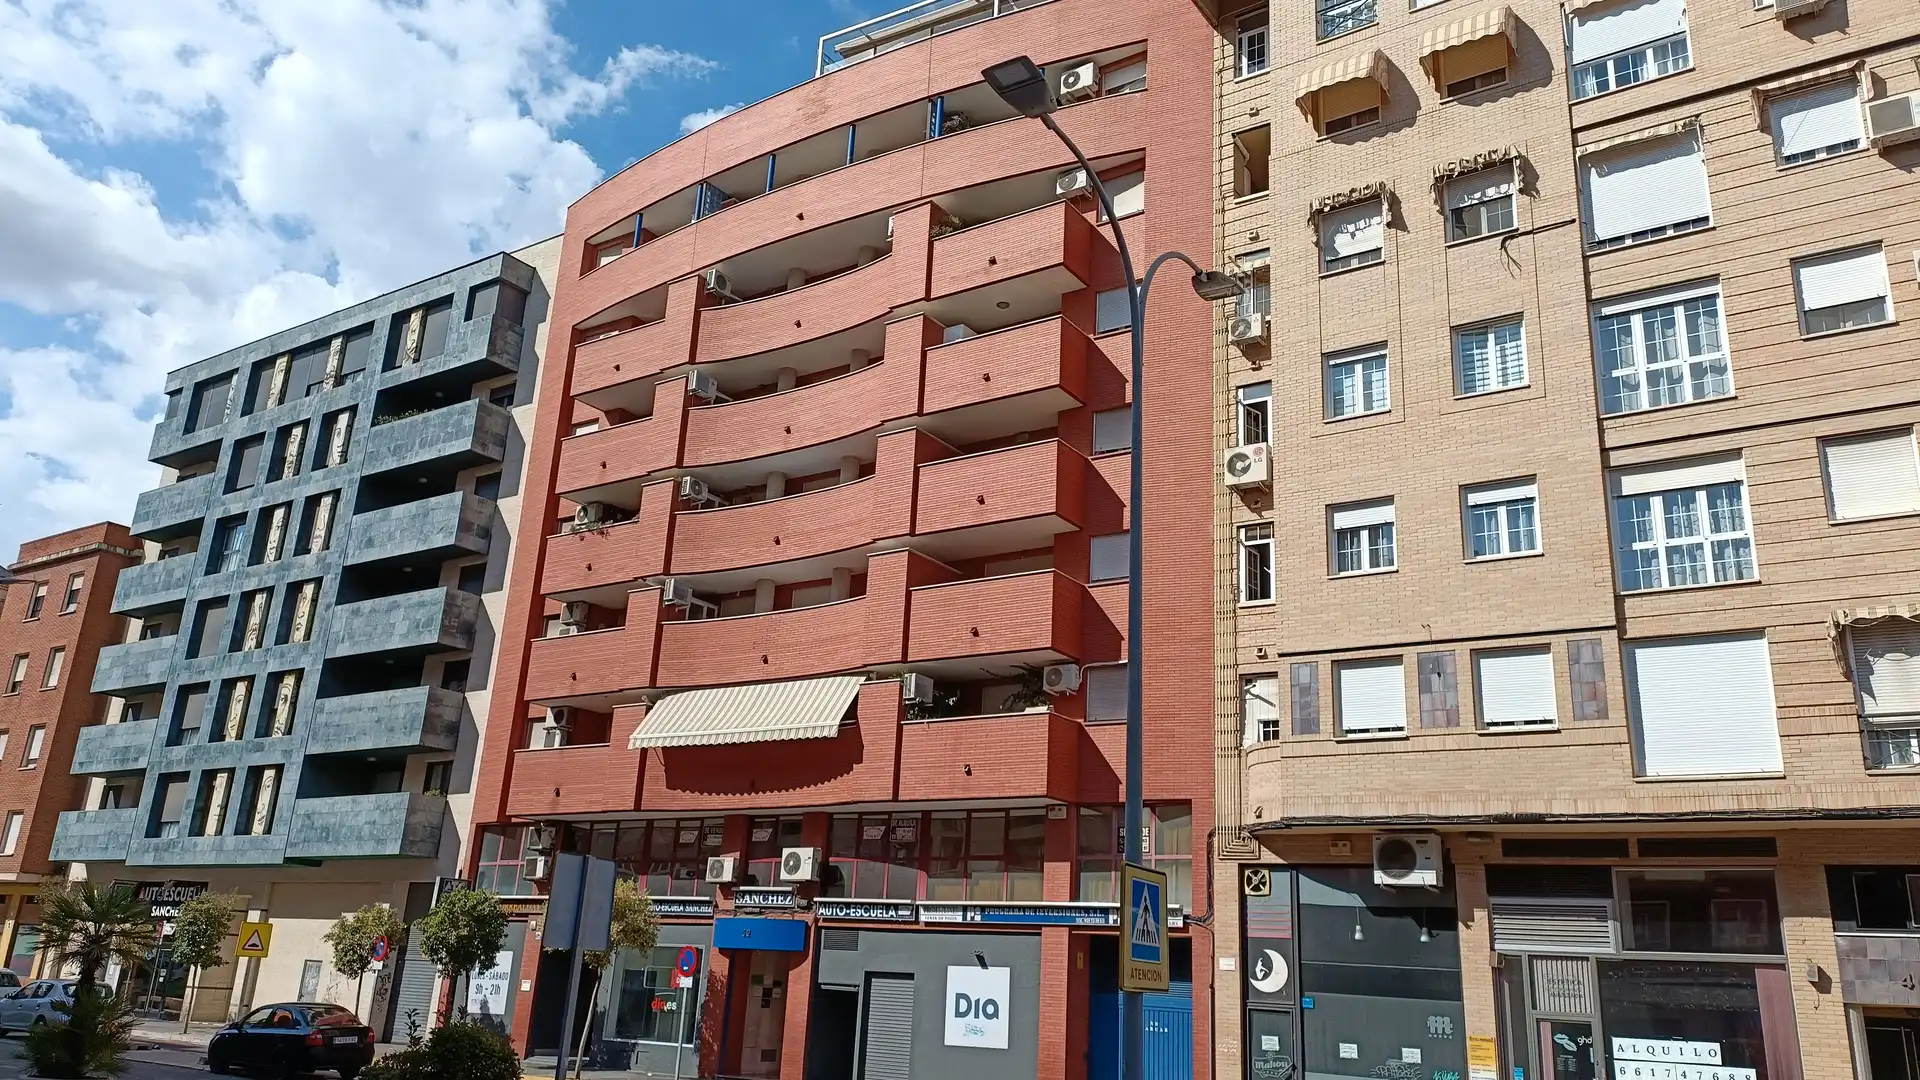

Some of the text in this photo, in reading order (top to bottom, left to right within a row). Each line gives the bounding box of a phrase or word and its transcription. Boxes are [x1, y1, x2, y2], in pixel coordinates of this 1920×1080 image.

[735, 892, 793, 905] SANCHEZ
[818, 902, 897, 918] AUTO-ESCUELA
[984, 907, 1024, 915] PROGRAMA
[1025, 907, 1036, 915] DE
[474, 983, 484, 995] 9h
[489, 984, 501, 995] 21h
[1616, 1043, 1718, 1058] ALQUILO
